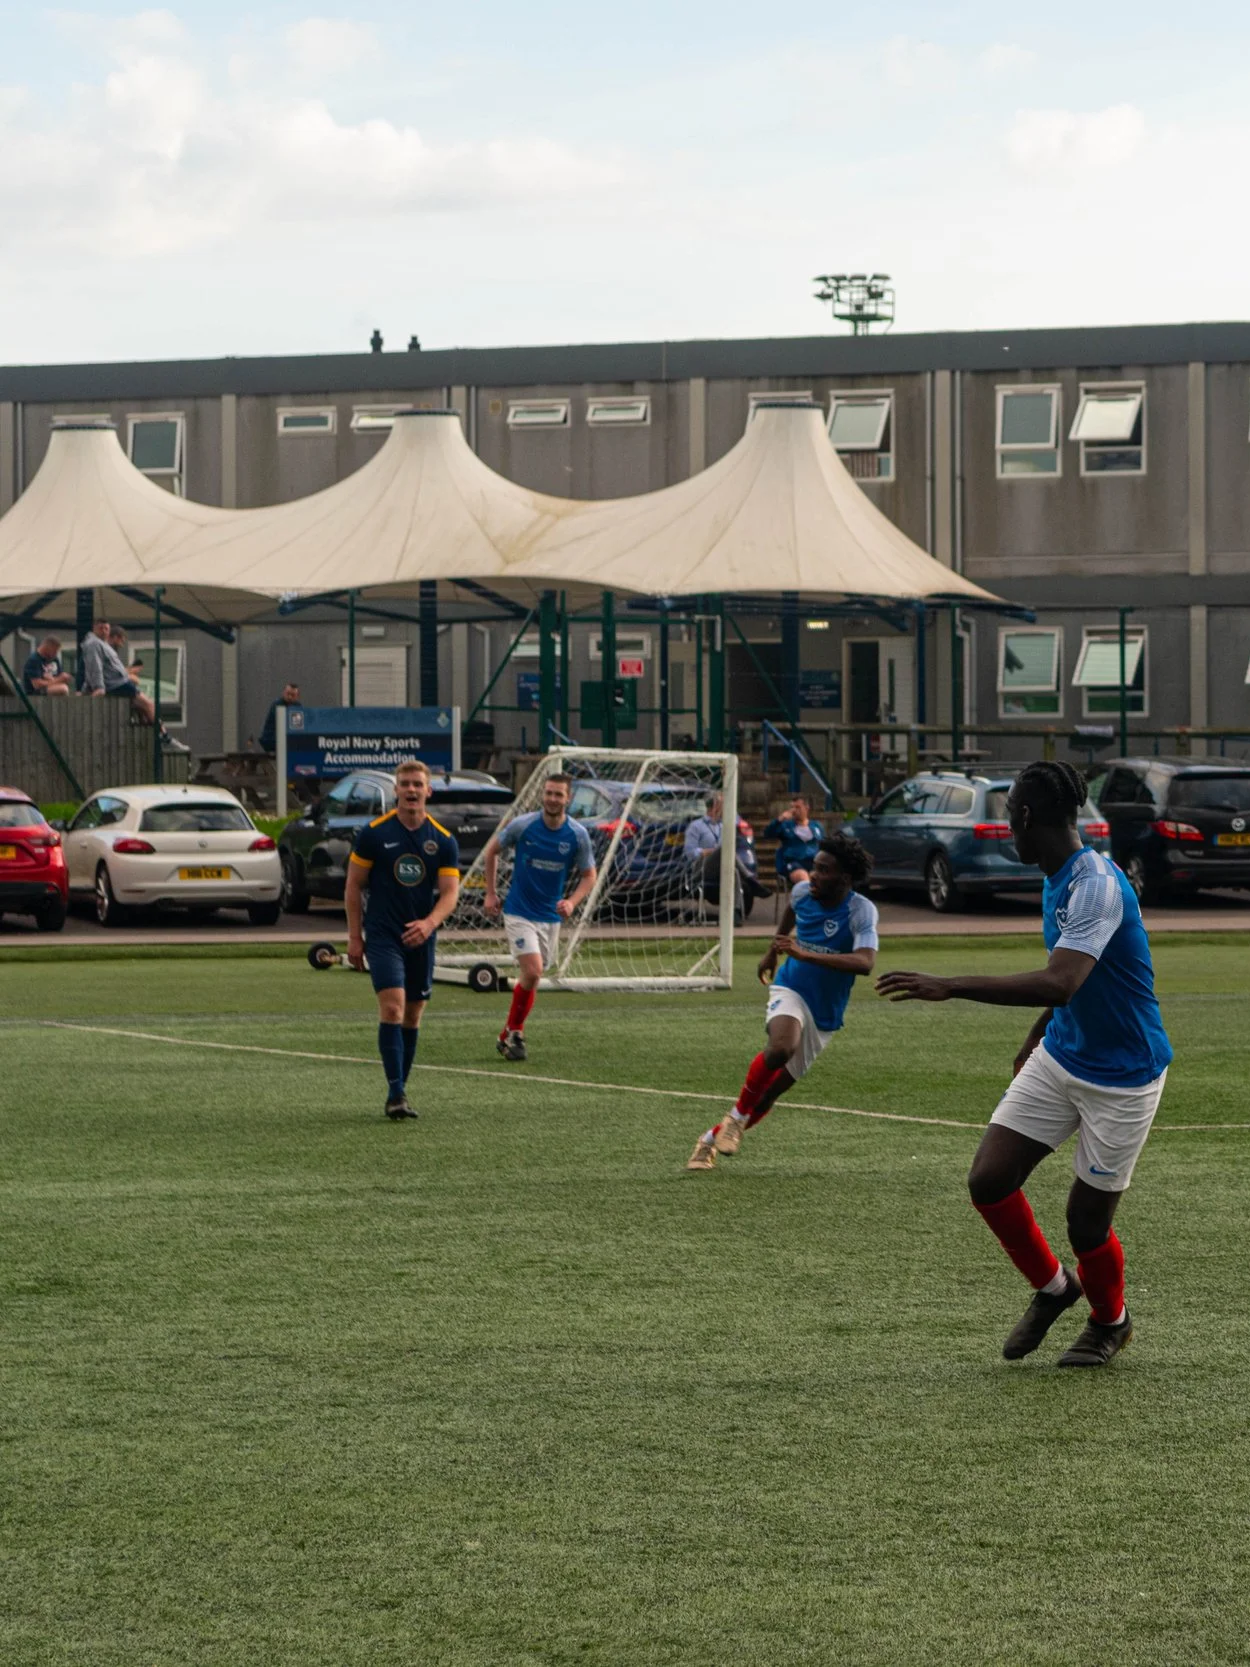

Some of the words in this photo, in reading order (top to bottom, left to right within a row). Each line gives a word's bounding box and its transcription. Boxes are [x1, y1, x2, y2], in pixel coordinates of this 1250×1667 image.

[318, 736, 350, 751] Royal
[352, 736, 381, 752] Navy
[384, 736, 420, 751] Sports
[325, 751, 416, 765] Accommodation
[399, 863, 421, 874] ESS
